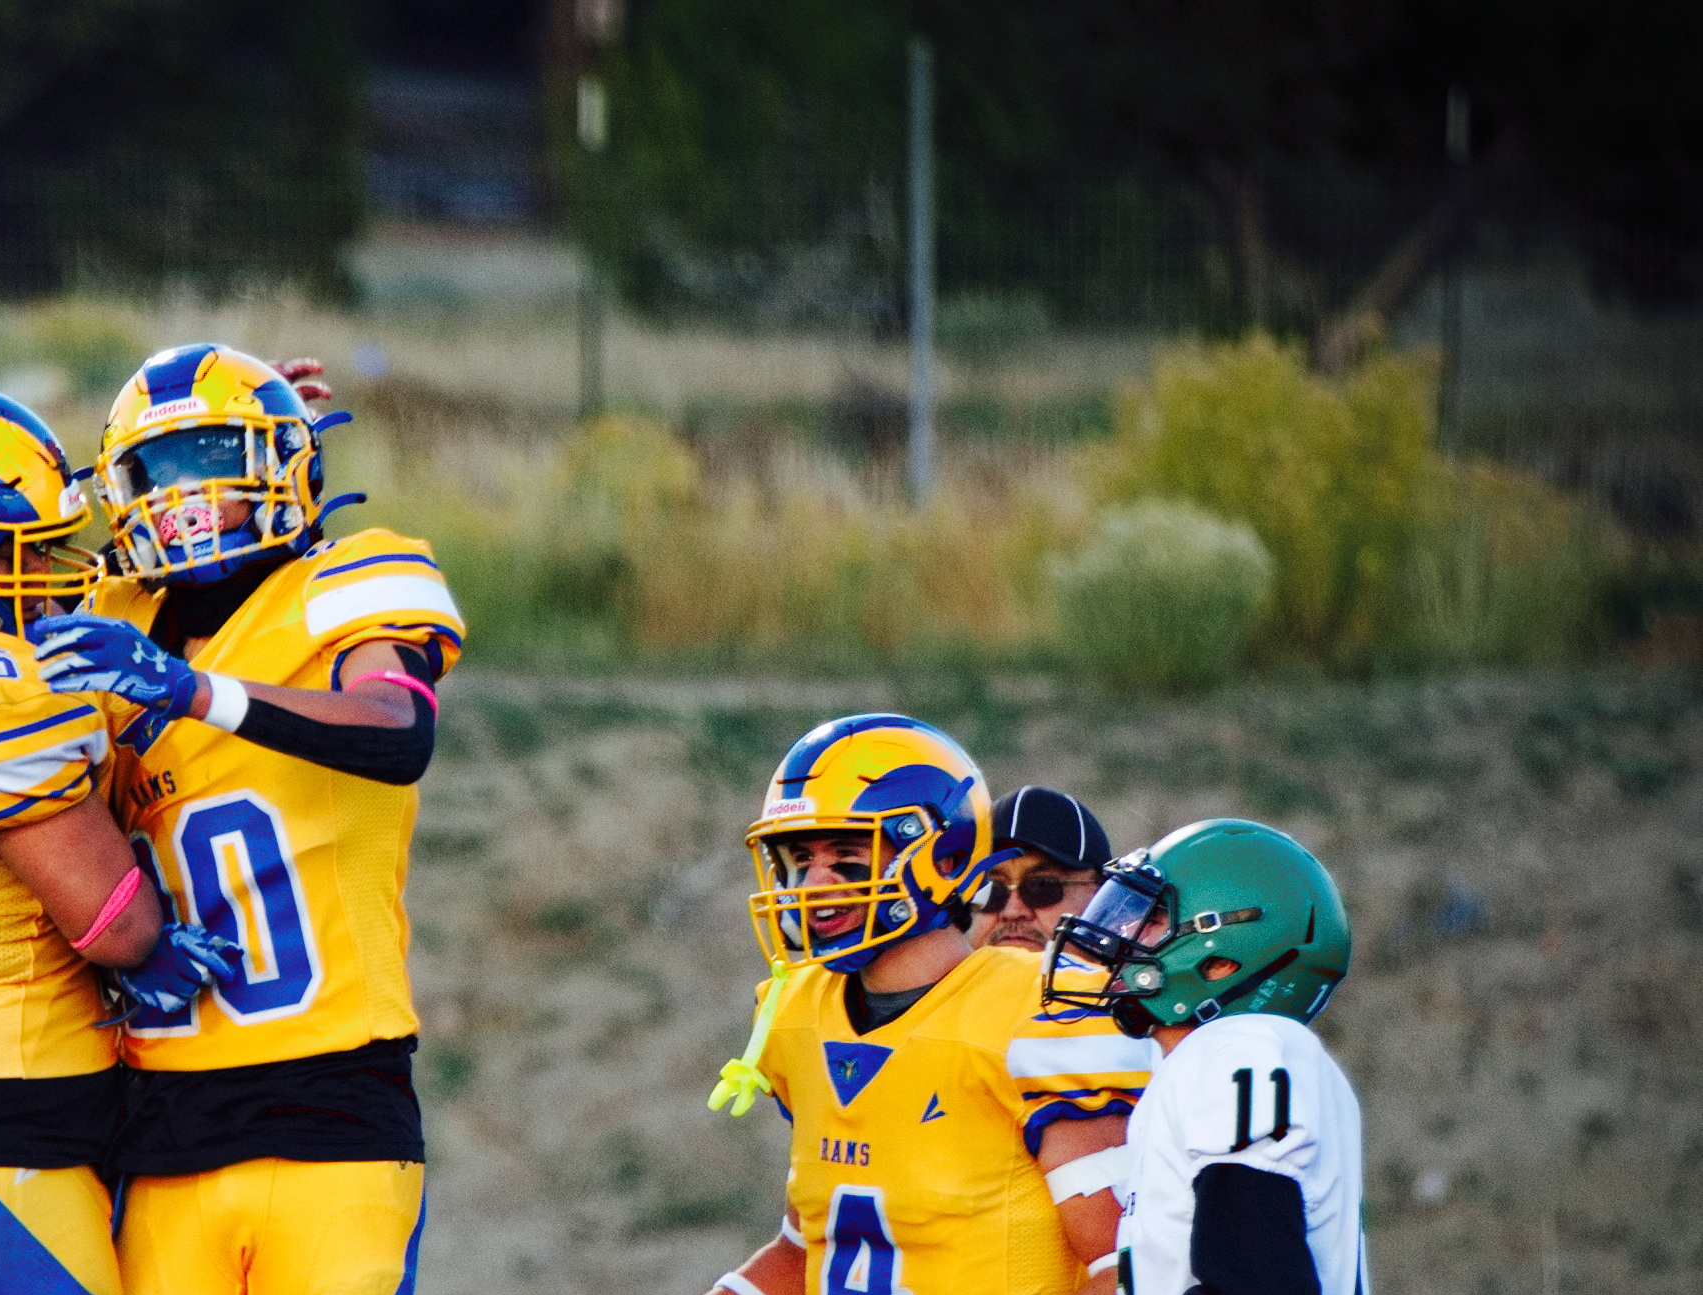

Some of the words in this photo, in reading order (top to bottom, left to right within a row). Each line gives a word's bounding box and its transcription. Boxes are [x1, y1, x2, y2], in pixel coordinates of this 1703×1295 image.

[143, 401, 197, 420] Riddell
[1230, 1066, 1292, 1153] 11
[820, 1136, 871, 1167] RAMS
